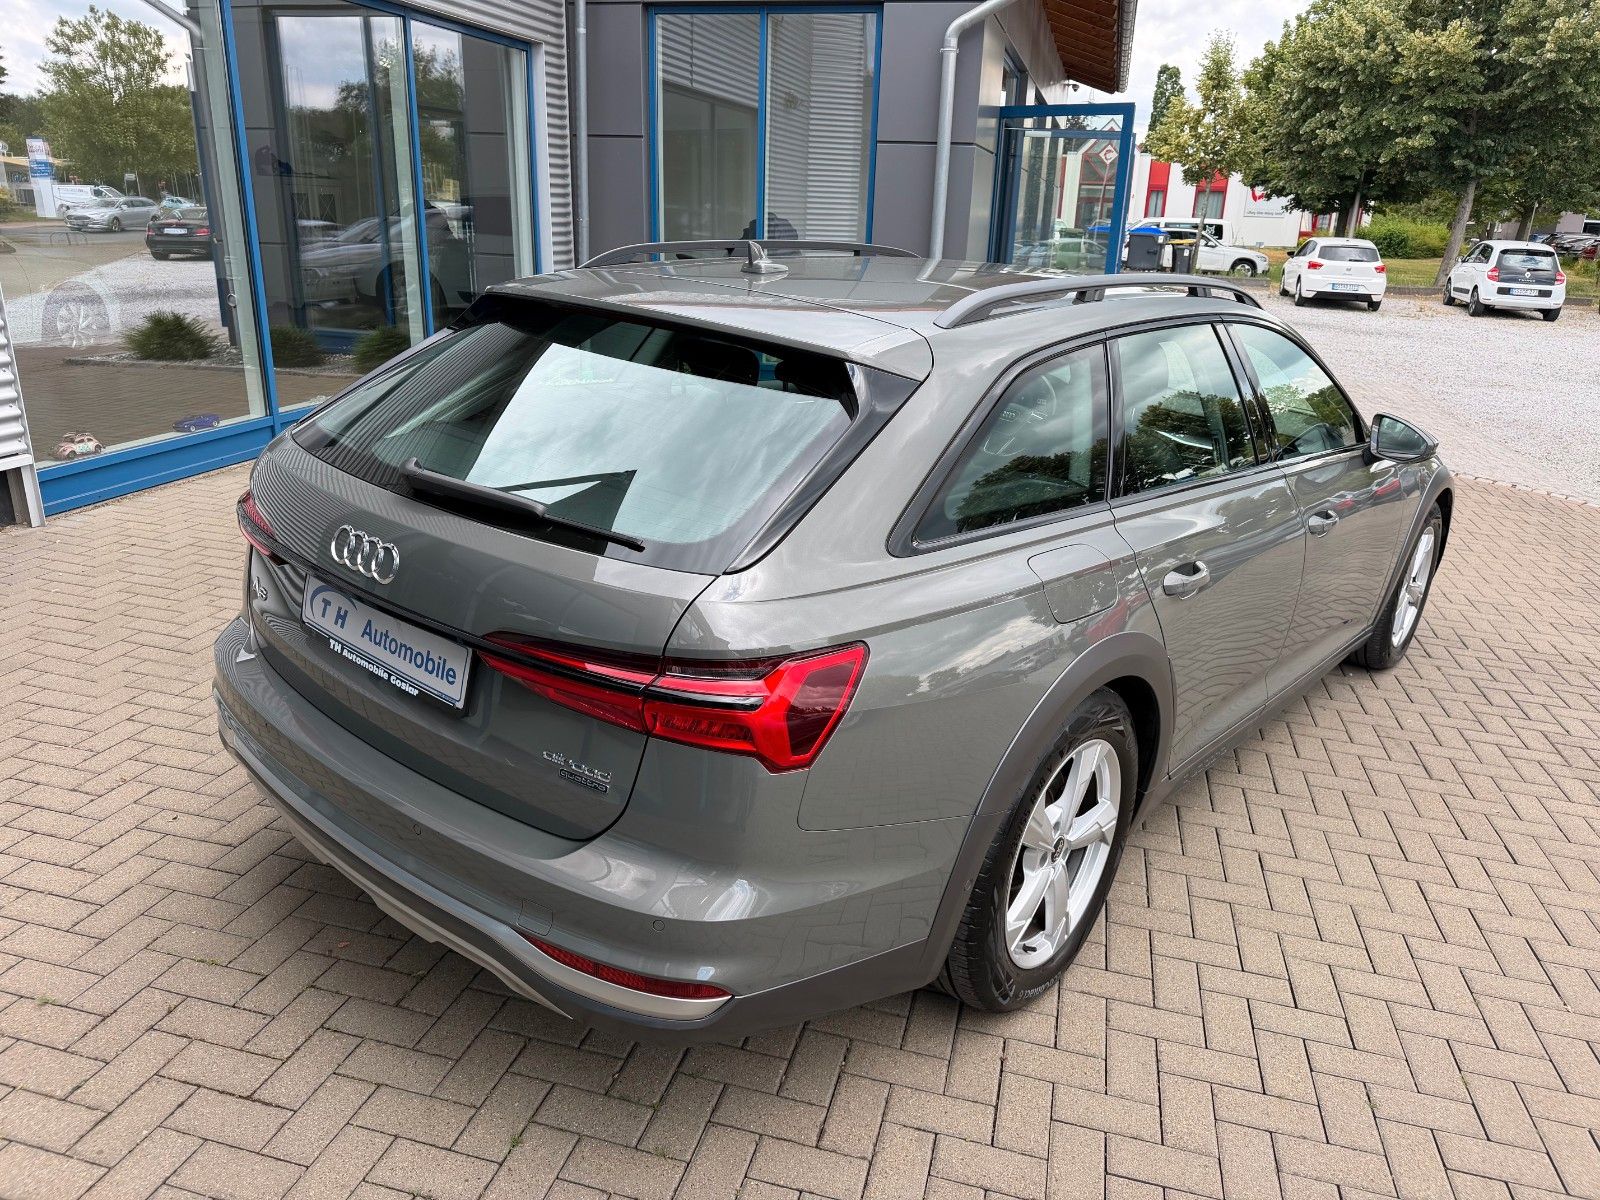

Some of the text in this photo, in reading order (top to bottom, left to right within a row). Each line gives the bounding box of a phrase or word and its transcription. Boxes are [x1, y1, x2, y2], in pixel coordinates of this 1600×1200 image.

[328, 639, 342, 654] TH
[342, 649, 389, 680] Automobile
[390, 675, 419, 697] Goslar
[360, 619, 457, 686] Automobile
[560, 769, 607, 793] quattro
